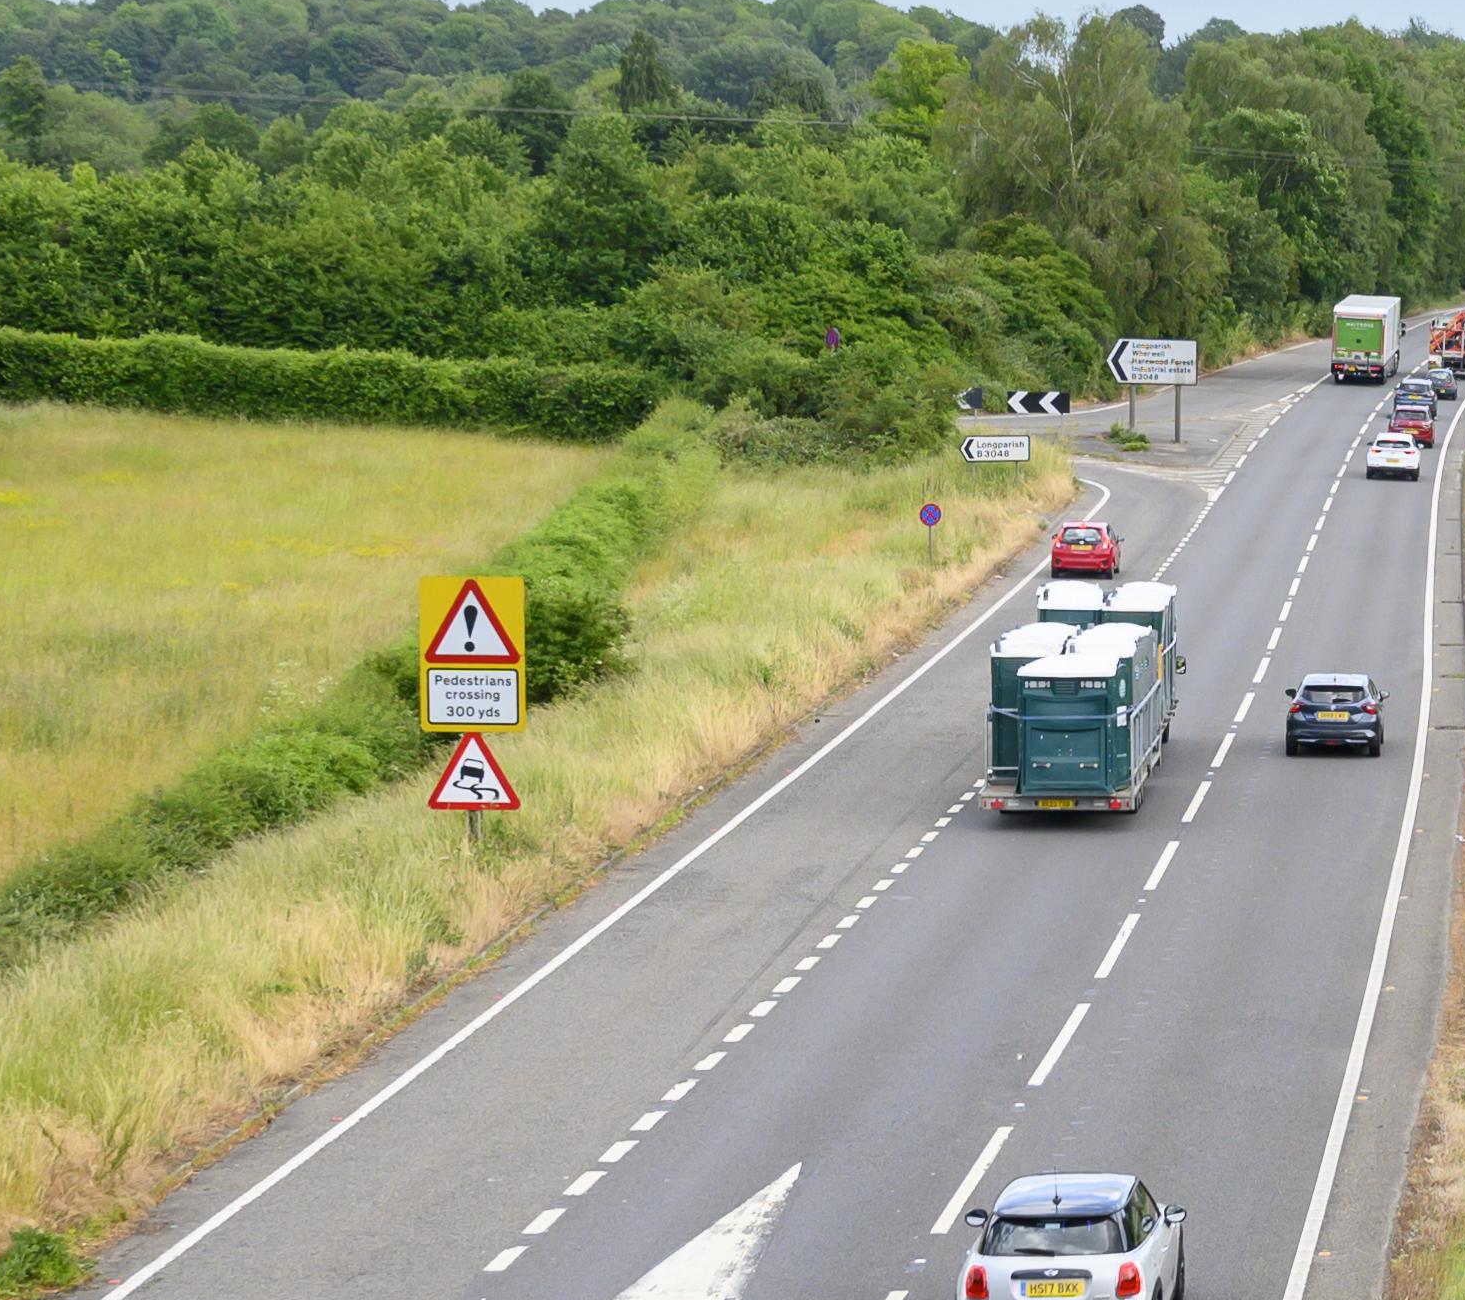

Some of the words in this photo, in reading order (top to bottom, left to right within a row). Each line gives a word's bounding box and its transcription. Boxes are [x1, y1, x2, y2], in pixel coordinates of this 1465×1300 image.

[1132, 342, 1172, 350] Longparish
[976, 440, 1025, 449] Longparish
[434, 675, 512, 687] Pedestrians
[445, 689, 501, 702] crossing
[446, 706, 475, 718] 300
[478, 706, 501, 720] yds
[1029, 1283, 1055, 1294] HS17
